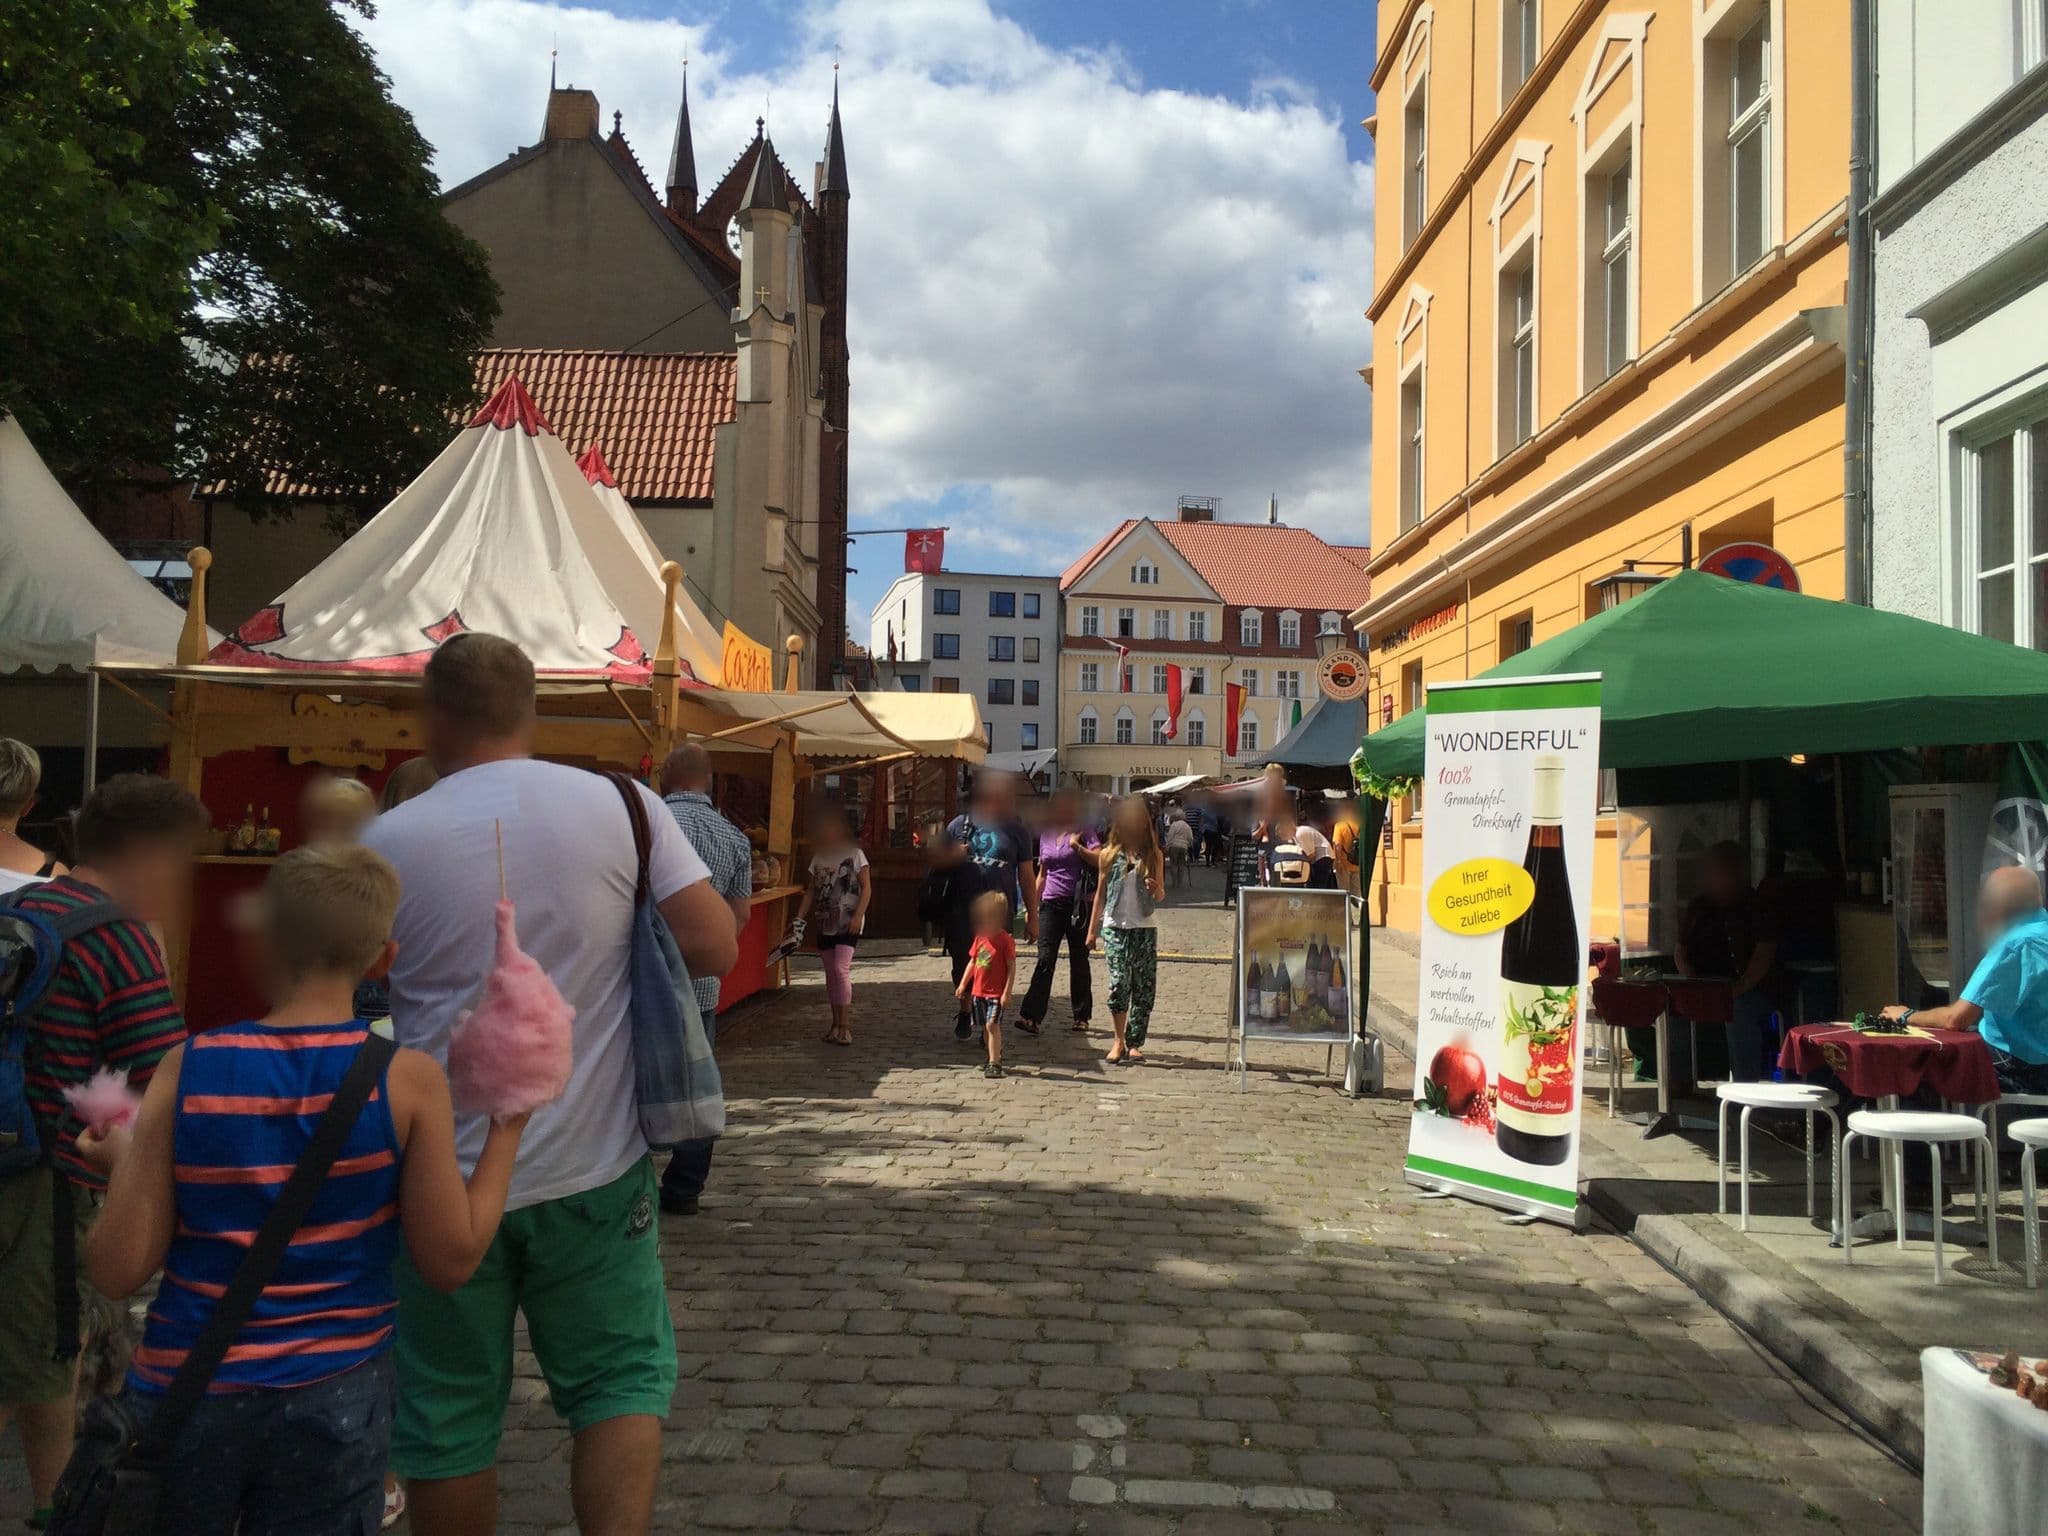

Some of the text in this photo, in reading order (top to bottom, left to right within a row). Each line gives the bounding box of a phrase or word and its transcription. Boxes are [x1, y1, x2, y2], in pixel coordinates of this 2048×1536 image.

[1325, 655, 1362, 671] MANDANI
[1128, 766, 1182, 775] ARTUSHOF
[1438, 766, 1472, 785] 100%
[1444, 788, 1505, 812] Granatapfel-
[1472, 812, 1522, 832] Direktsaft
[1462, 868, 1489, 885] Ihrer
[1445, 883, 1512, 909] Gesundheit
[1460, 908, 1501, 928] zuliebe
[1431, 962, 1472, 980] Reich an
[1430, 986, 1475, 1004] wertvollen
[1430, 1006, 1496, 1031] Inhaltsstoffen!
